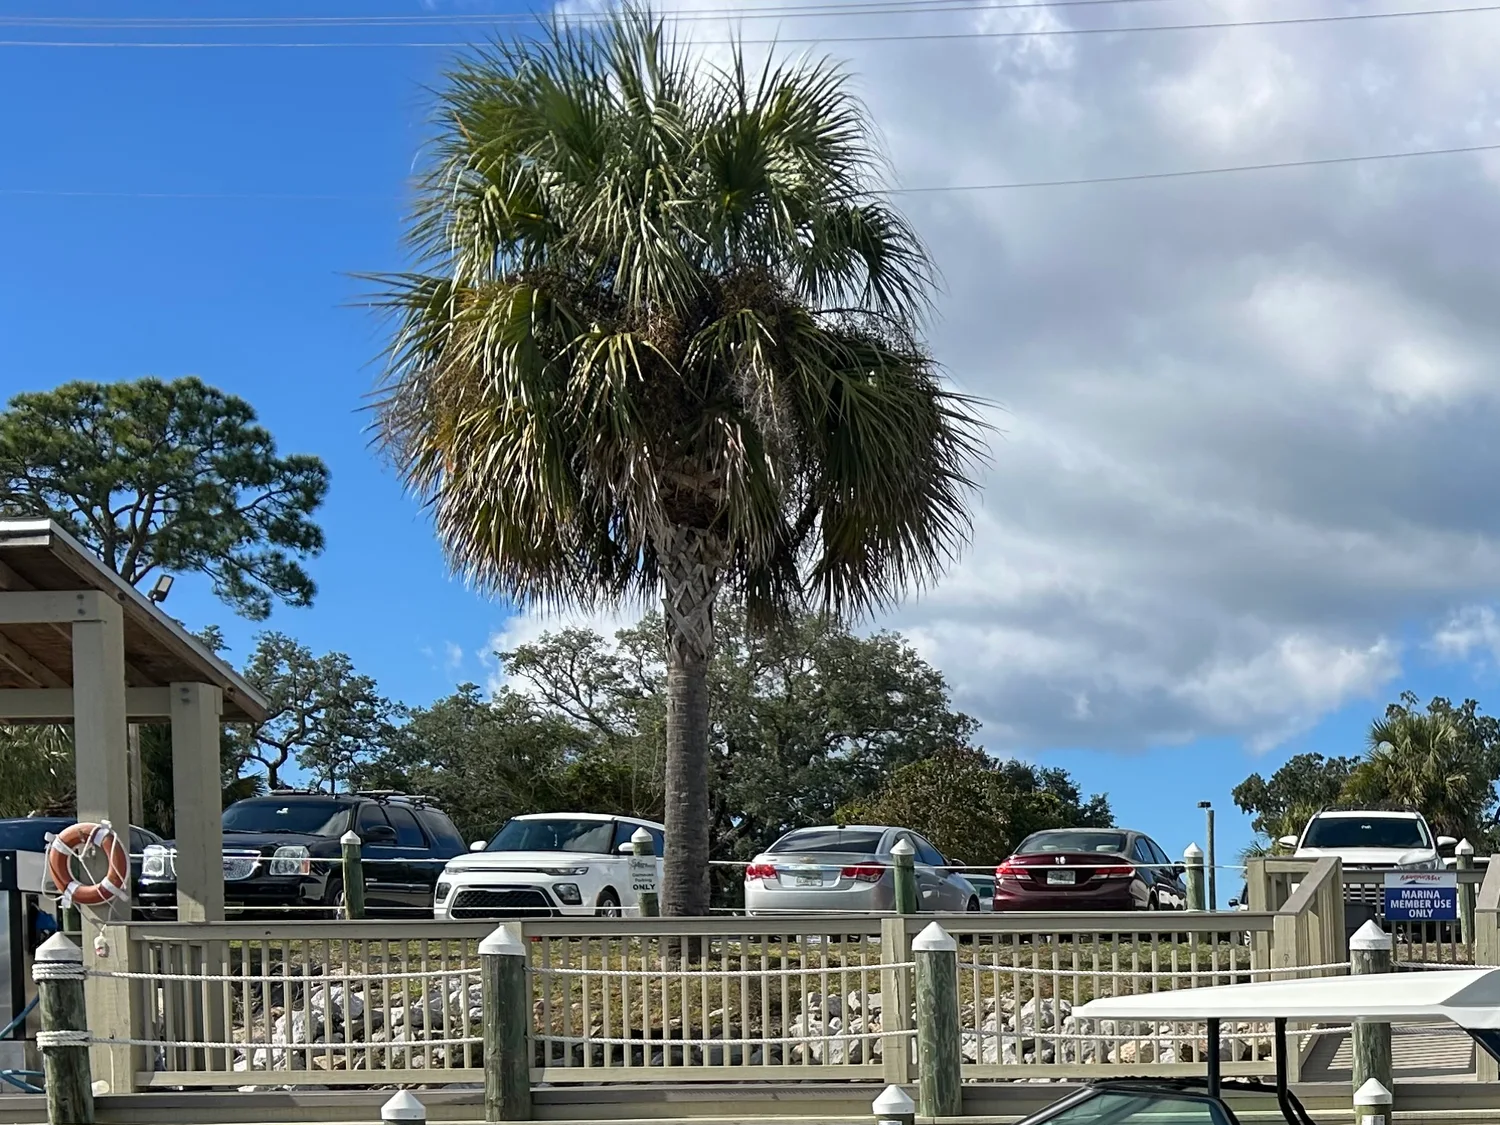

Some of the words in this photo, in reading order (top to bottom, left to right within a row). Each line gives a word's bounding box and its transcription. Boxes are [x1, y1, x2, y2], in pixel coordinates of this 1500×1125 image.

[1401, 890, 1440, 899] MARINA
[1390, 900, 1431, 908] MEMBER
[1434, 900, 1452, 908] USE
[1408, 909, 1433, 918] ONLY
